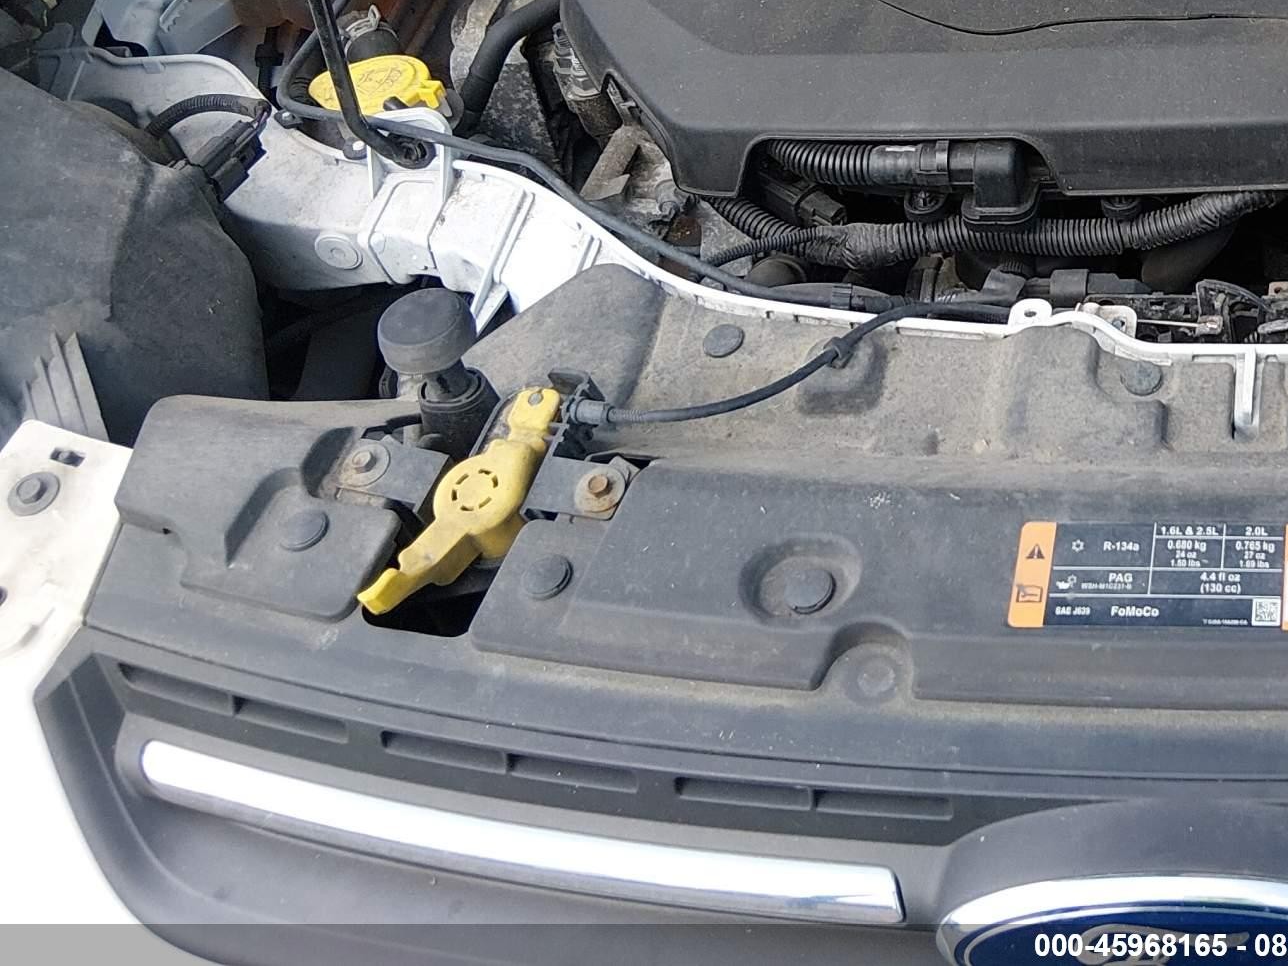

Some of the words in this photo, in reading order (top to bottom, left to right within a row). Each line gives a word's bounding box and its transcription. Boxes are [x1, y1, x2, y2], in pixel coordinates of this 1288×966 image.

[1161, 526, 1183, 535] 1.6L
[1185, 525, 1194, 535] &
[1196, 526, 1219, 536] 2.5L
[1245, 526, 1268, 536] 2.0L
[1103, 541, 1140, 551] R-134a
[1194, 539, 1207, 553] kg
[1235, 540, 1261, 551] 0.765
[1262, 540, 1276, 554] kg
[1186, 551, 1197, 559] oz
[1244, 550, 1255, 559] 27
[1255, 552, 1266, 560] oz
[1188, 559, 1201, 567] lbs
[1256, 560, 1270, 569] lbs
[1108, 572, 1133, 583] PAG
[1200, 571, 1217, 582] 4.4
[1218, 571, 1226, 582] fl
[1227, 573, 1241, 582] oz
[1200, 582, 1223, 595] (130
[1224, 582, 1242, 595] cc)
[1110, 605, 1160, 617] FoMoCo
